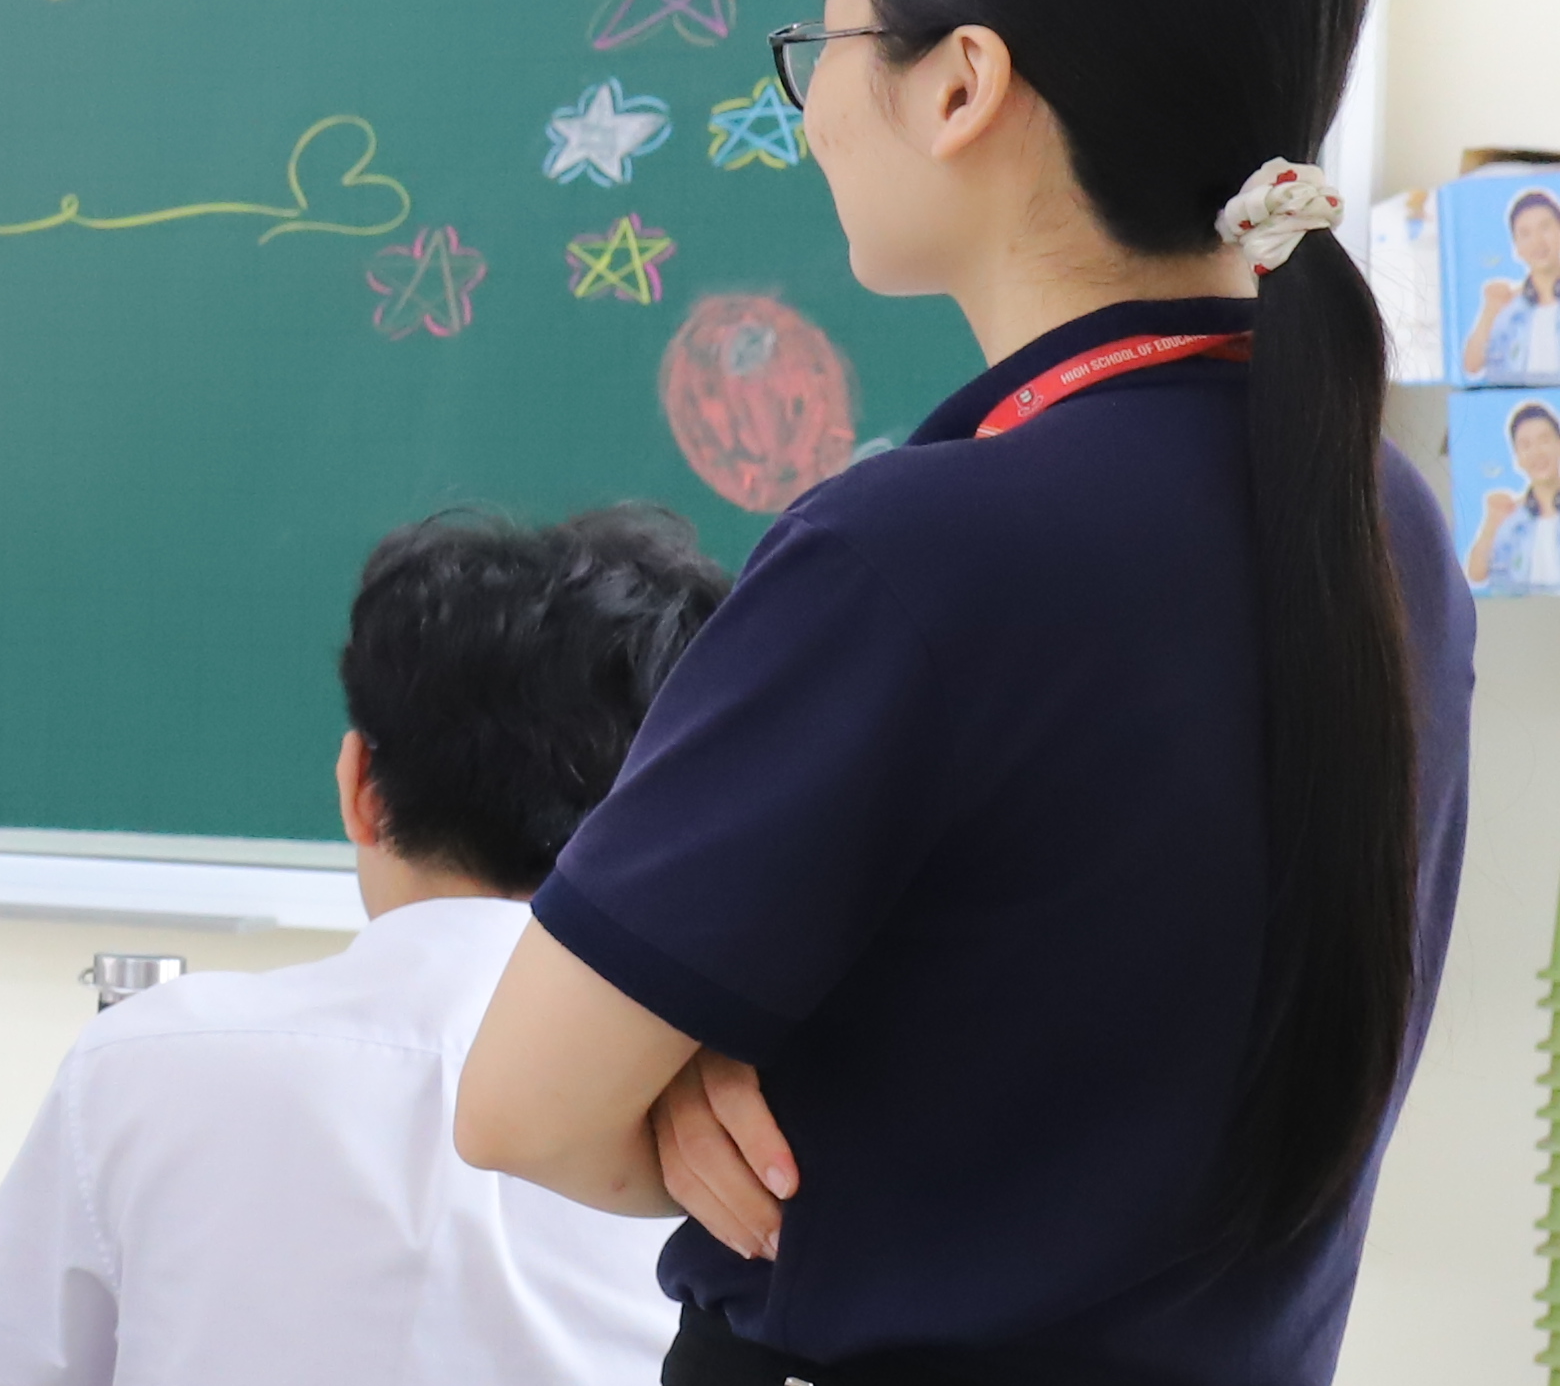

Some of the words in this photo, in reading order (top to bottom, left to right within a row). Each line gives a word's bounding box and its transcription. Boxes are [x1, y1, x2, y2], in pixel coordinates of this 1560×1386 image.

[1060, 364, 1090, 385] HIGH
[1090, 349, 1138, 371] SCHOOL
[1138, 342, 1154, 357] OF
